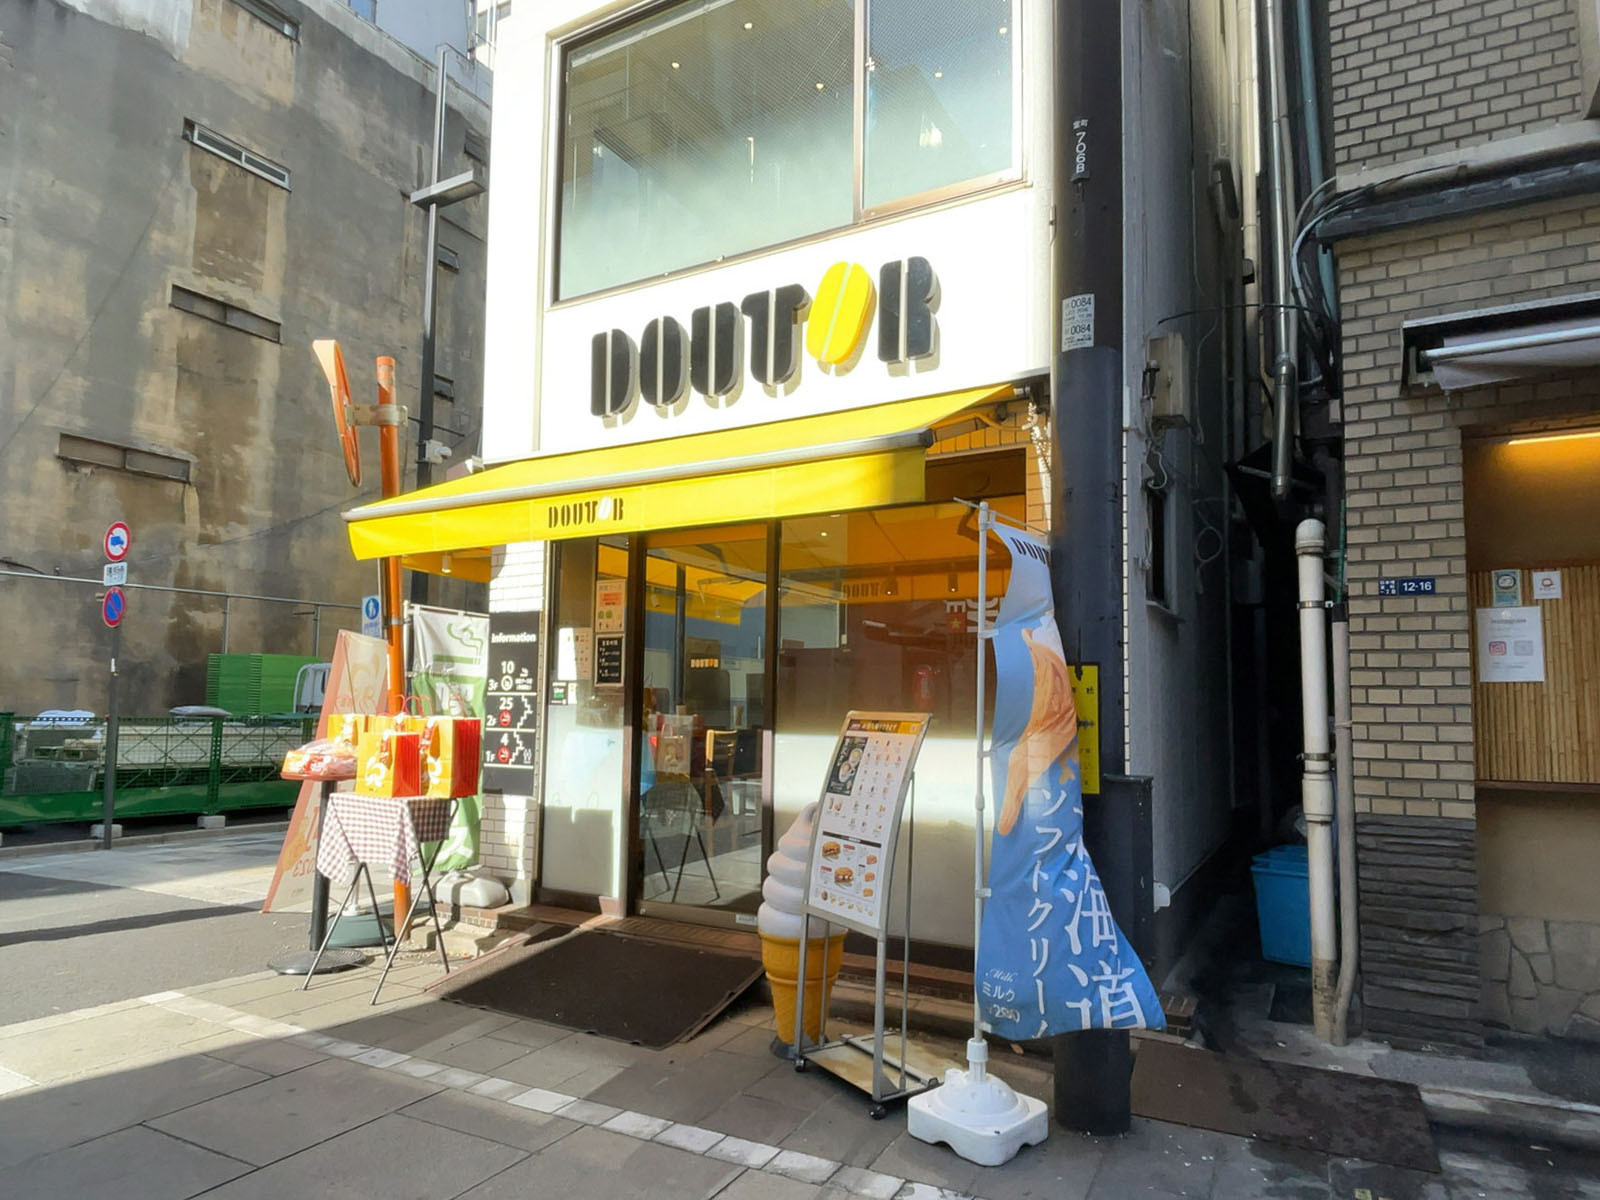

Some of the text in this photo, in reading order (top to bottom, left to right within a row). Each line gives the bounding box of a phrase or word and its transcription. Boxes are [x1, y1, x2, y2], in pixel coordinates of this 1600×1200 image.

[1075, 131, 1087, 174] 706B
[1071, 297, 1092, 308] 0084
[1070, 324, 1091, 335] 0084
[591, 256, 938, 420] DOUTOR
[548, 497, 624, 529] DOUTOR
[491, 632, 537, 643] Information
[501, 660, 515, 675] 10
[499, 697, 514, 710] 25
[500, 733, 509, 746] 4
[982, 981, 1016, 1003] ミルク
